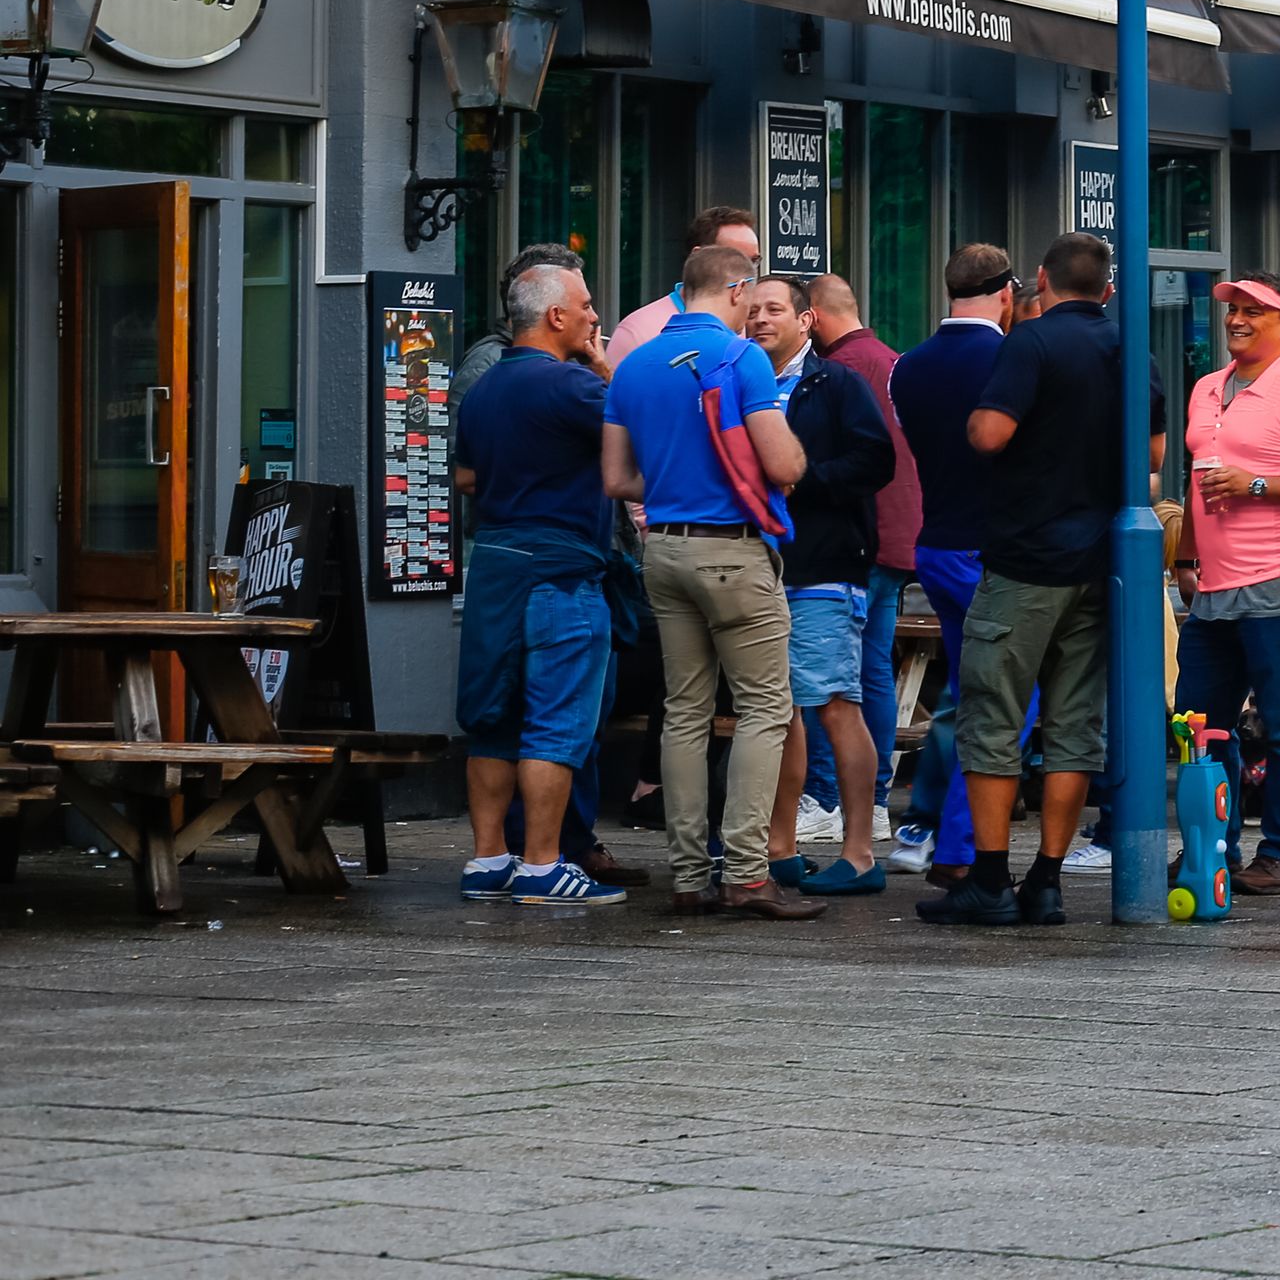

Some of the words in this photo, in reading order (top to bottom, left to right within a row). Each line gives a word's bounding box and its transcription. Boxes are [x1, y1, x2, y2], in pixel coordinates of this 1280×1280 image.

[771, 131, 823, 163] BREAKFAST
[772, 169, 802, 187] served
[803, 168, 820, 191] from
[1080, 170, 1115, 199] HAPPY
[779, 198, 817, 237] 8AM
[1080, 199, 1115, 230] HOUR
[777, 243, 800, 266] every
[802, 241, 821, 268] day
[402, 281, 435, 299] Belushi's
[243, 503, 291, 558] HAPPY
[245, 542, 293, 600] HOUR
[392, 580, 447, 592] www.belushis.com
